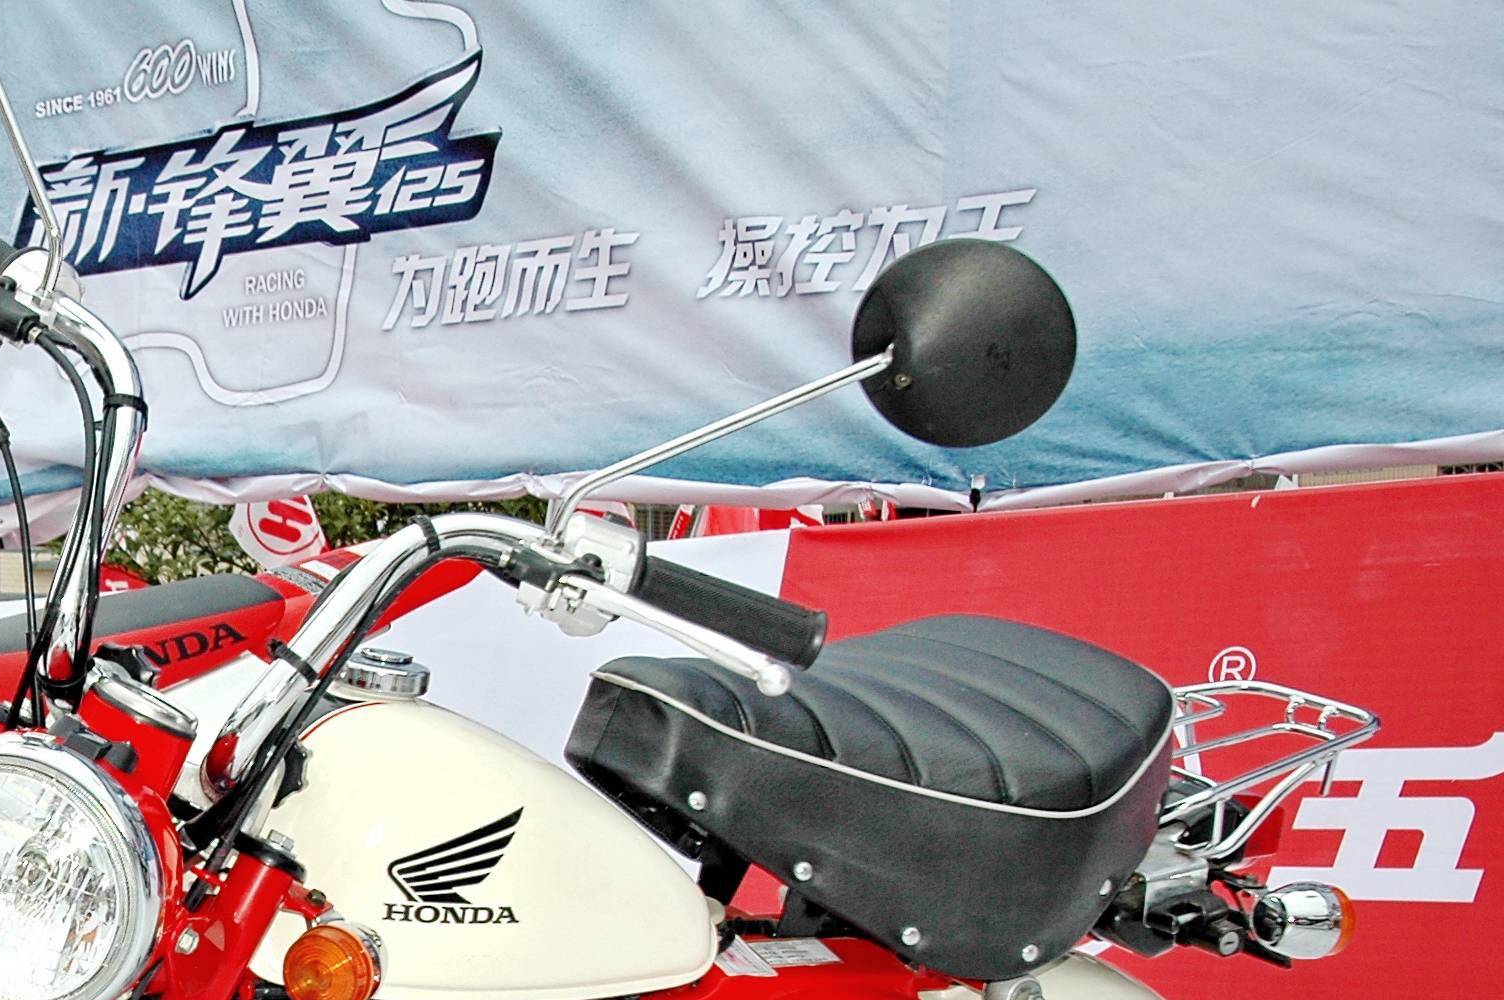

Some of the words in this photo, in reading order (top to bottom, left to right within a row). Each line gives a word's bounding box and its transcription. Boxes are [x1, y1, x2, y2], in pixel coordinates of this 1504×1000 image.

[35, 94, 83, 118] SINCE
[88, 87, 121, 108] 1961
[124, 39, 194, 102] 600
[197, 50, 235, 86] WINS
[372, 158, 484, 217] 125
[245, 269, 304, 295] RACING
[380, 228, 640, 331] 为跑而生
[223, 304, 263, 327] WITH
[268, 297, 327, 323] HONDA
[143, 621, 248, 666] NDA
[382, 902, 519, 924] HONDA
